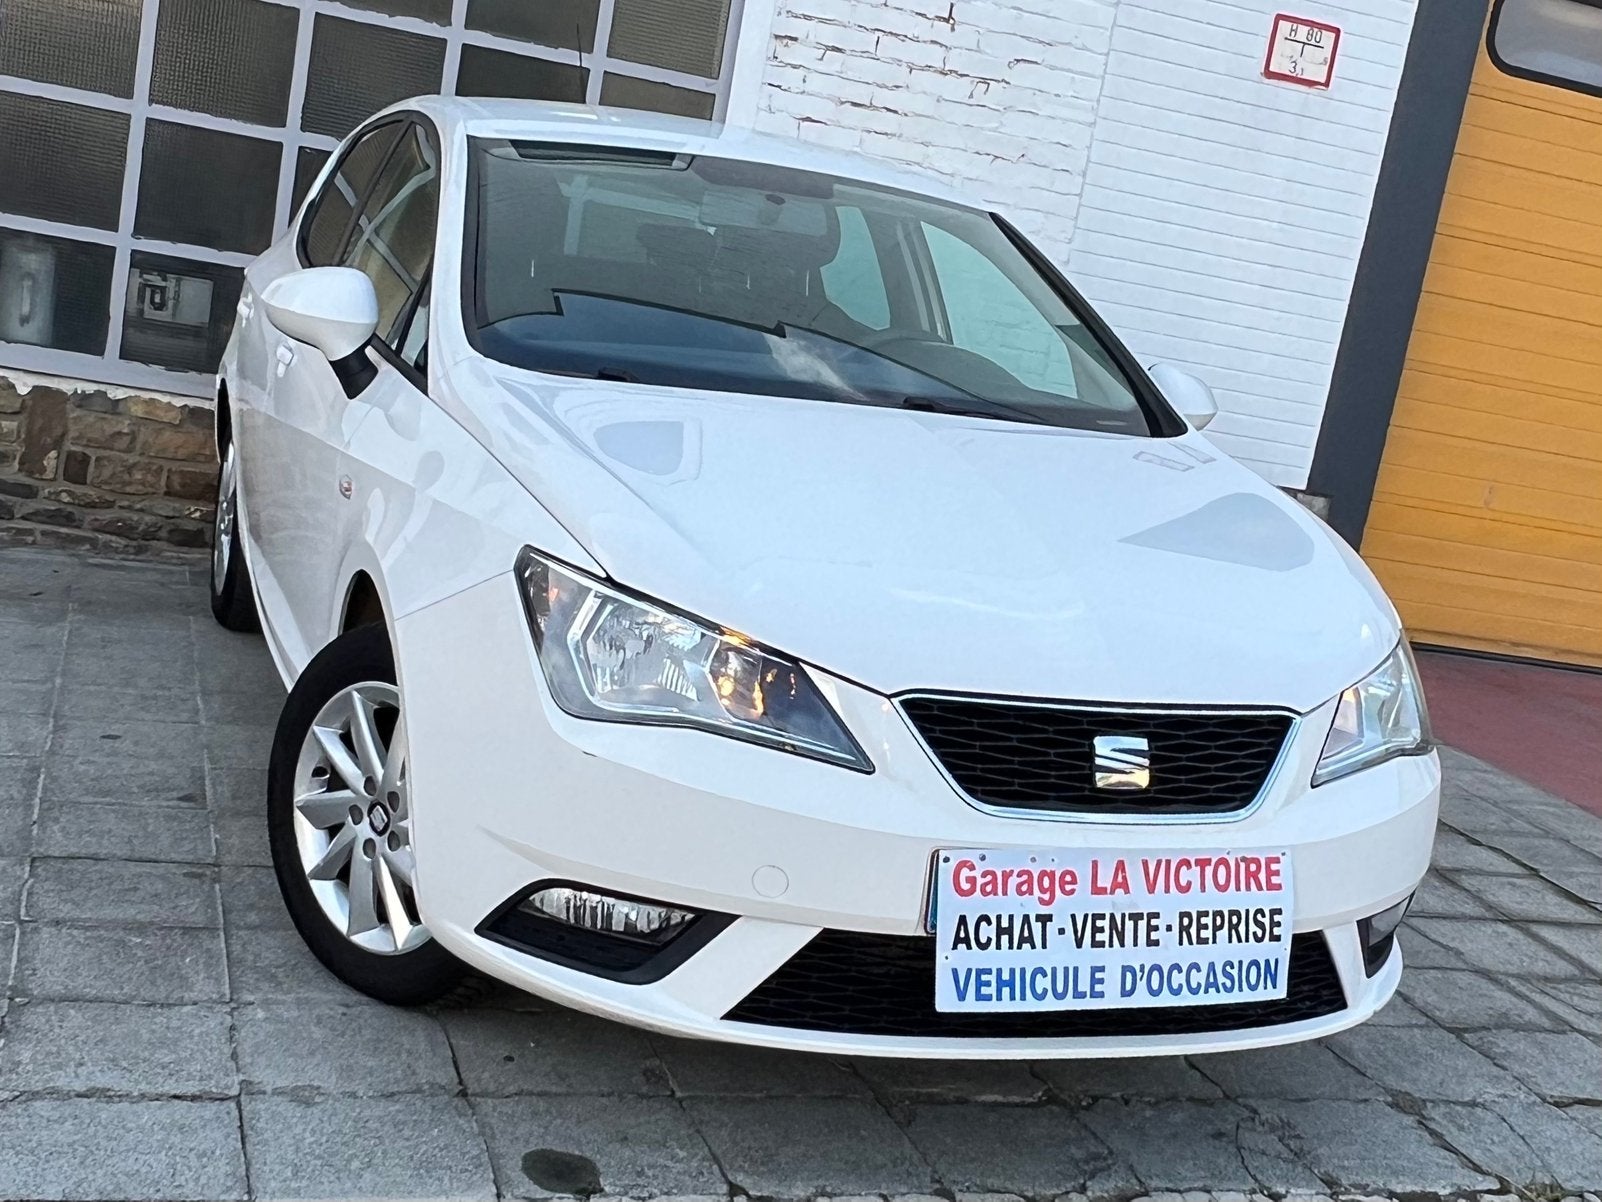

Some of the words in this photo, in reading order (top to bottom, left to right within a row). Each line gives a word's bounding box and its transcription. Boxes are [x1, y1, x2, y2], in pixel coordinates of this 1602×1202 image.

[1289, 25, 1299, 38] H
[1305, 28, 1323, 44] 80
[952, 859, 1079, 907] Garage
[1090, 858, 1130, 896] LA
[1141, 856, 1283, 895] VICTOIRE
[951, 965, 1106, 1002] VEHICULE
[1120, 957, 1280, 998] D'OCCASION
